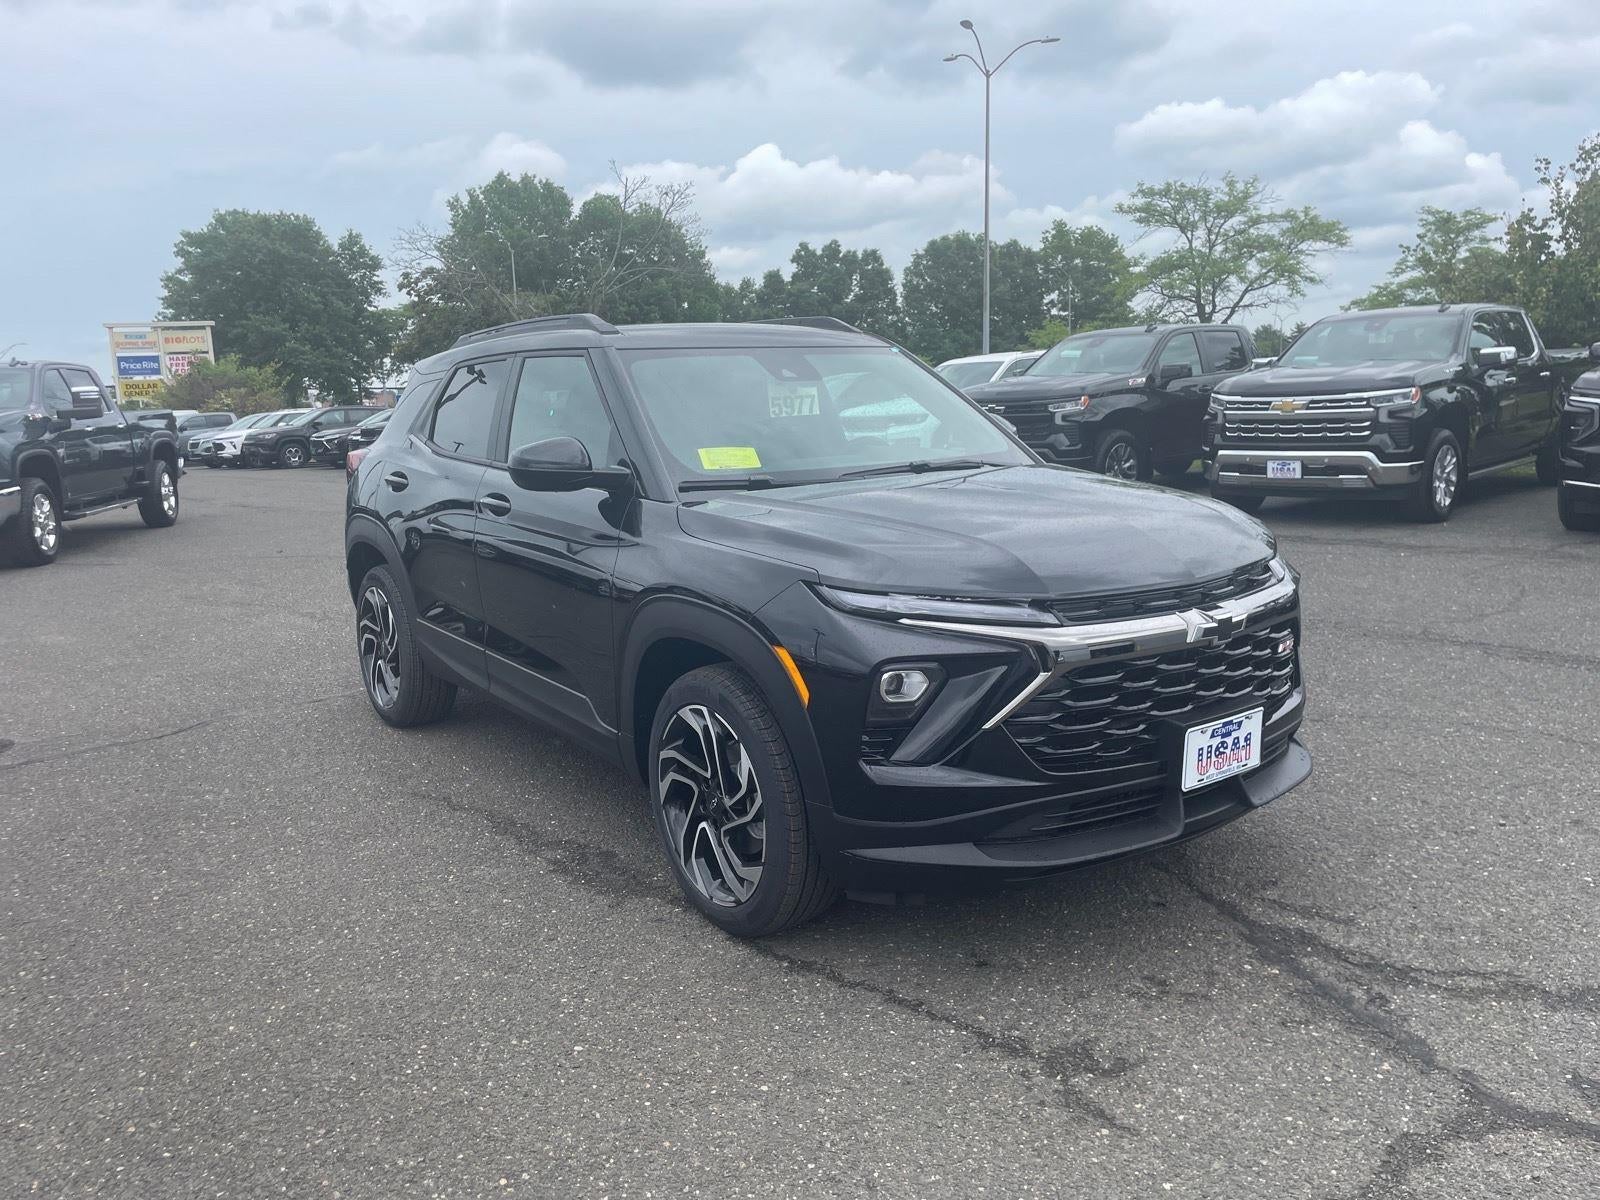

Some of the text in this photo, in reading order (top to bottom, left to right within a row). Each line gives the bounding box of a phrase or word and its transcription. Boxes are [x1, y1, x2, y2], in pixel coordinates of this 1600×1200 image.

[120, 361, 142, 370] Price
[142, 361, 159, 369] Rite
[770, 394, 816, 417] 5977
[1214, 724, 1240, 736] CENTRAL
